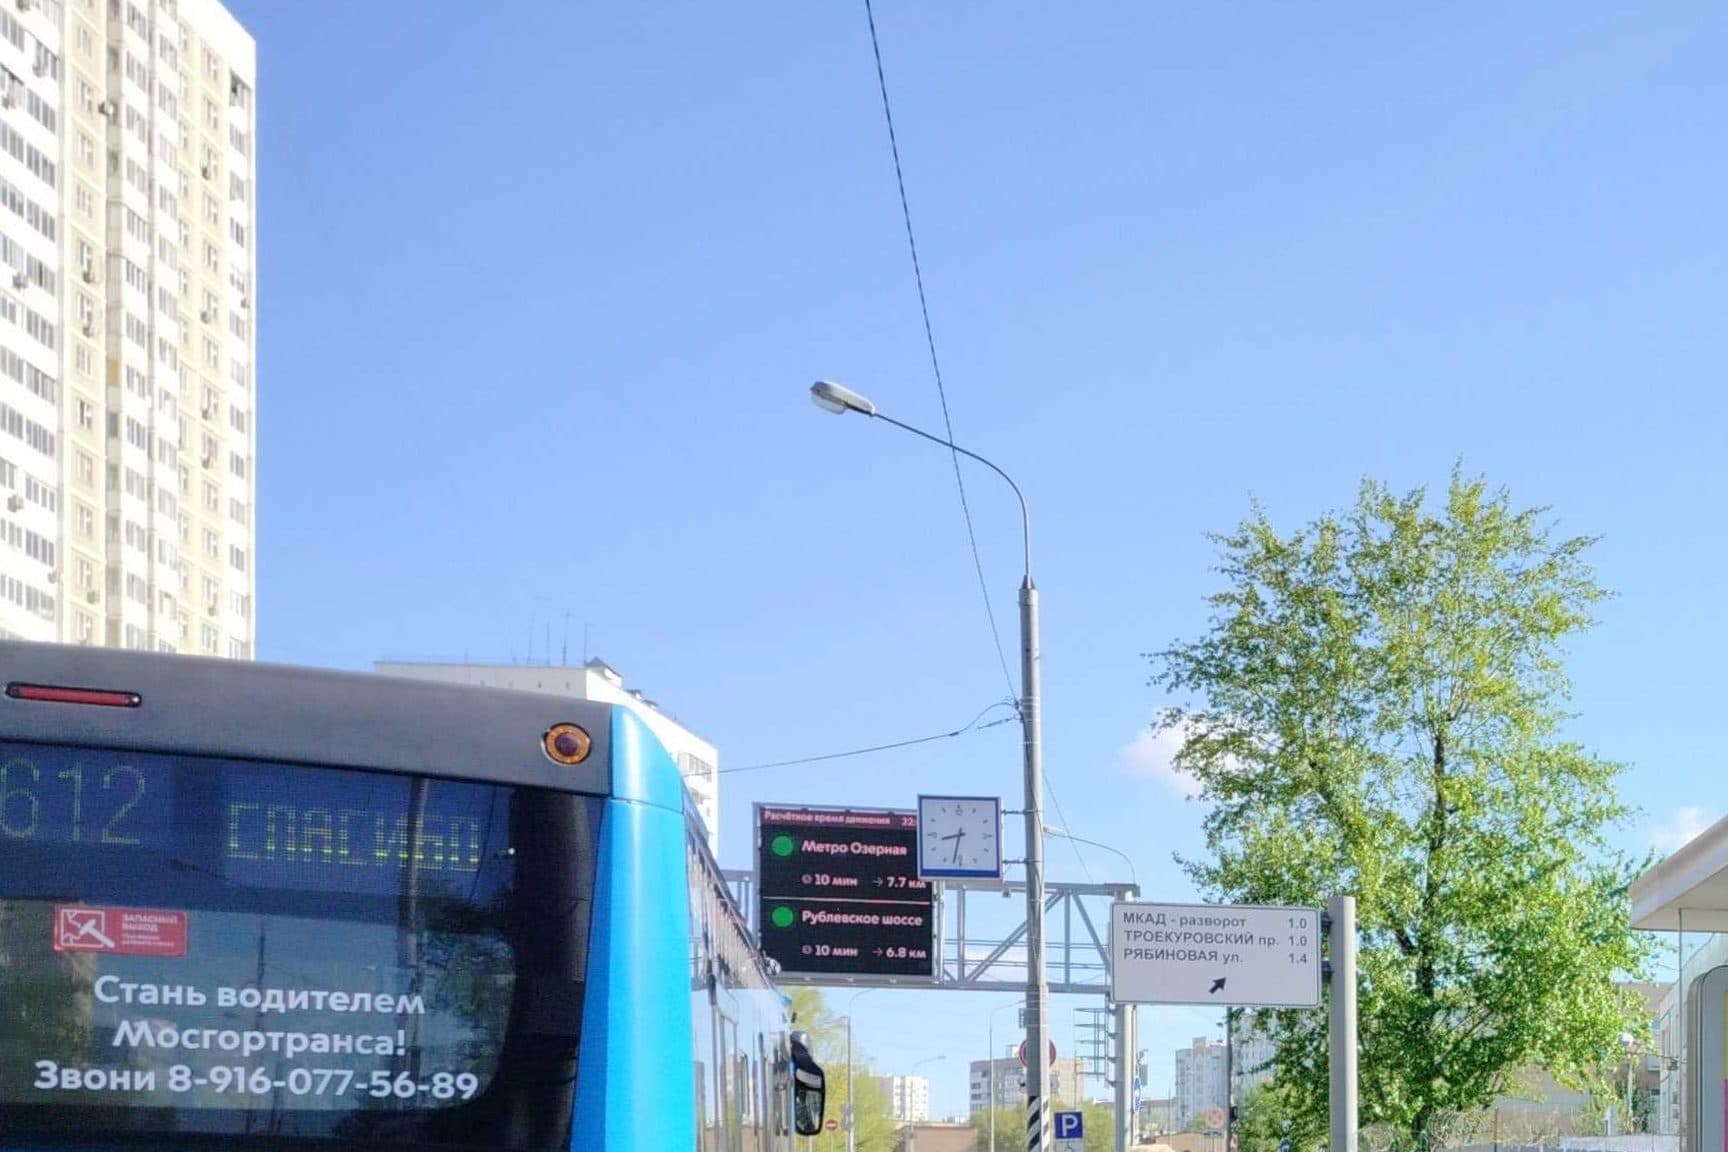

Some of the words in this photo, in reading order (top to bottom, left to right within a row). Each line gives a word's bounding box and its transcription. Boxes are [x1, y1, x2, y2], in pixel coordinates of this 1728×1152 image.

[0, 757, 146, 845] 612
[802, 840, 848, 857] Метро
[850, 842, 908, 857] Озерная
[815, 874, 830, 886] 10
[832, 877, 858, 887] мин
[887, 876, 906, 888] 7.7
[802, 910, 880, 925] Рублевское
[882, 915, 923, 927] шоссе
[1123, 912, 1167, 926] МКАД
[1179, 915, 1247, 930] разворот
[1288, 918, 1308, 930] 1.0
[1124, 930, 1254, 945] ТРОЕКУРОВСКИЙ
[1258, 936, 1280, 949] пр.
[1288, 935, 1308, 947] 1.0
[815, 945, 830, 957] 10
[832, 948, 858, 957] мин
[886, 946, 906, 959] 6.8
[909, 950, 927, 959] км
[1124, 948, 1218, 963] РЯБИНОВАЯ
[1222, 954, 1244, 965] ул.
[1288, 953, 1308, 964] 1.4
[94, 975, 207, 1006] Стань
[217, 986, 426, 1015] водителем
[112, 1019, 406, 1058] Мосгортранса!
[34, 1059, 156, 1091] Звони
[168, 1063, 479, 1100] 8-916-077-56-89
